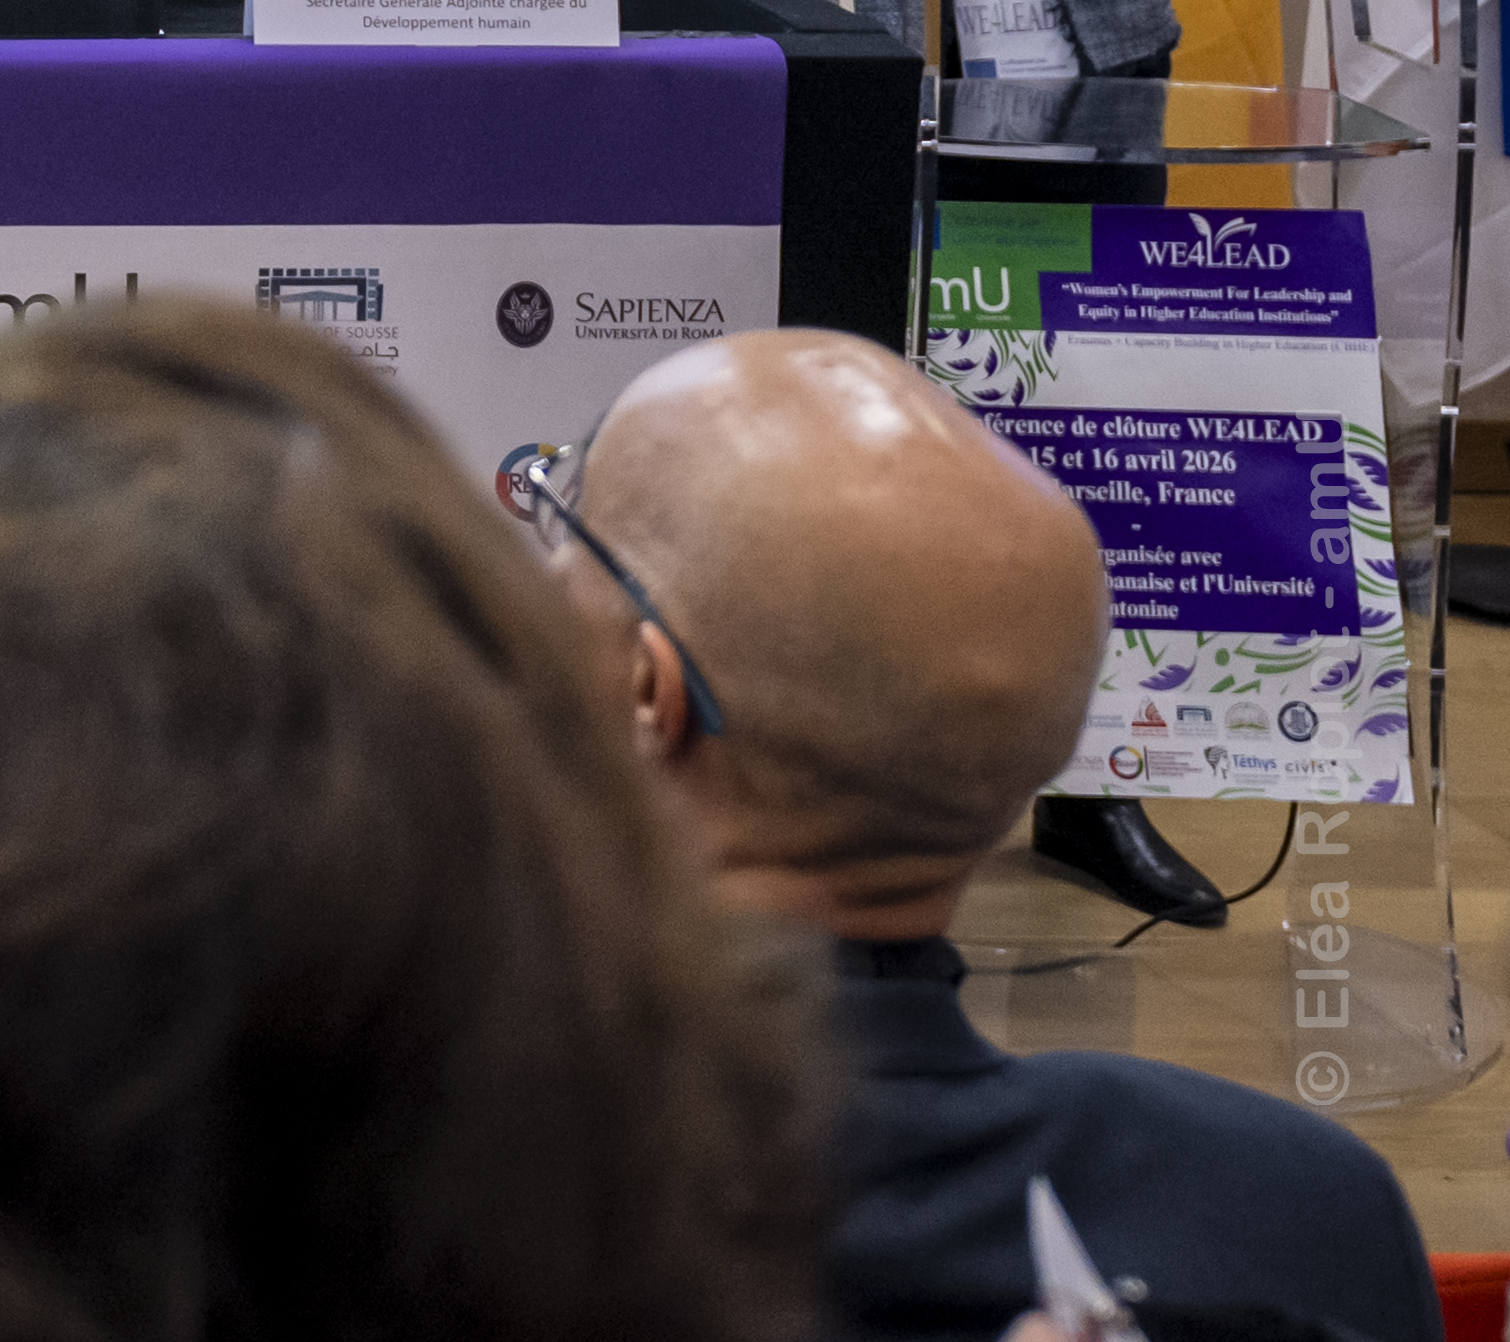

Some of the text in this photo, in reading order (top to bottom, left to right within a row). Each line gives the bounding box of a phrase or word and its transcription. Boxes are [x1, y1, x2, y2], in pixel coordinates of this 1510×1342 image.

[362, 16, 531, 31] Développement humain
[1139, 227, 1291, 270] WE4LEAD
[1131, 284, 1223, 303] Empowerment
[1227, 285, 1249, 301] For
[1254, 287, 1325, 305] Leadership
[1329, 289, 1352, 304] and
[575, 292, 725, 324] SAPIENZA
[1078, 304, 1121, 321] Equity
[1124, 305, 1137, 319] in
[1140, 305, 1185, 322] Higher
[1189, 307, 1254, 321] Education
[345, 325, 399, 340] SOUSSE
[575, 323, 660, 341] UNIVERSITÀ
[663, 326, 678, 340] DI
[1072, 415, 1323, 443] de clôture WE4LEAD
[1062, 450, 1084, 469] et
[1091, 448, 1119, 470] 16
[1125, 448, 1175, 472] avril
[1182, 450, 1237, 473] 2026
[1158, 482, 1235, 506] France
[1181, 551, 1222, 566] avec
[1179, 577, 1198, 593] et
